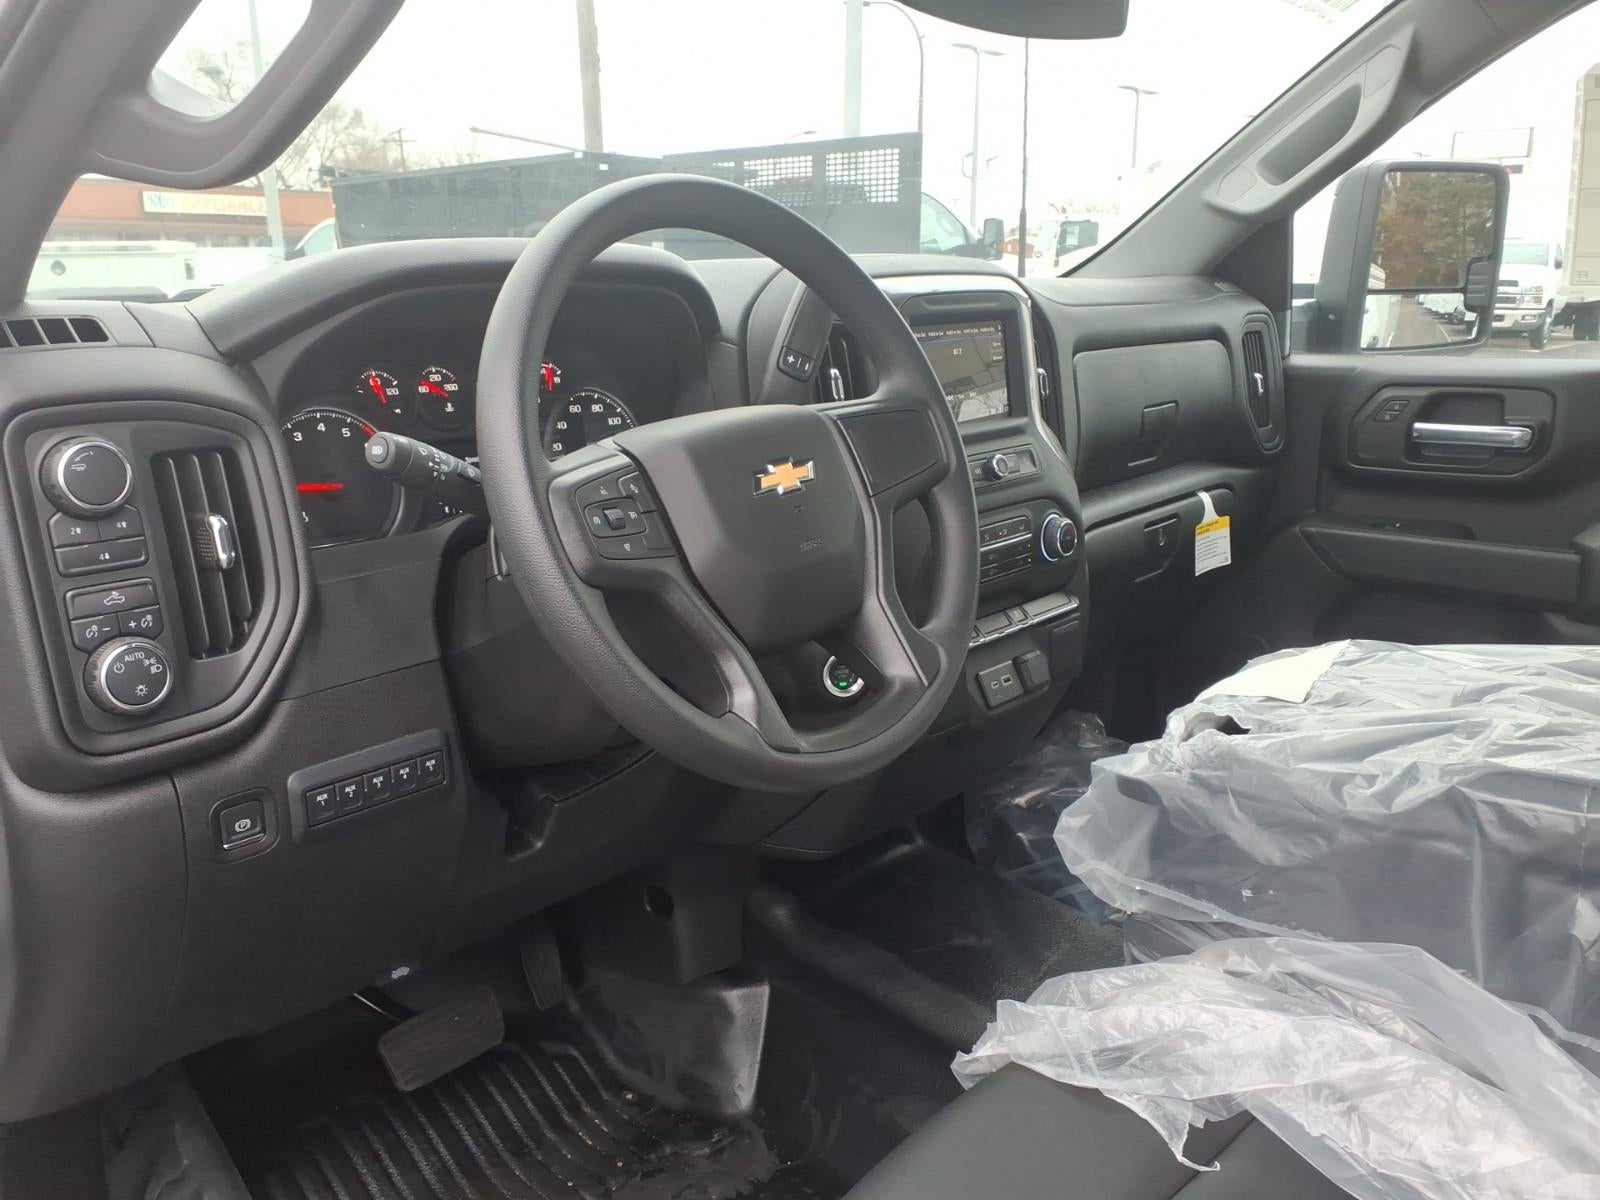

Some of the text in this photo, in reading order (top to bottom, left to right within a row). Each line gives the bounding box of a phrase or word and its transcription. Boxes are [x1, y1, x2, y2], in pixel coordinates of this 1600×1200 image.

[569, 404, 581, 413] 60
[591, 404, 603, 412] 80
[607, 417, 621, 425] 100
[316, 422, 326, 432] 4
[293, 431, 302, 441] 3
[341, 427, 351, 437] 5
[124, 651, 145, 662] AUTO
[426, 759, 435, 767] AUX
[399, 767, 410, 775] AUX
[372, 776, 384, 784] AUX
[344, 785, 356, 793] AUX
[316, 793, 328, 802] AUX
